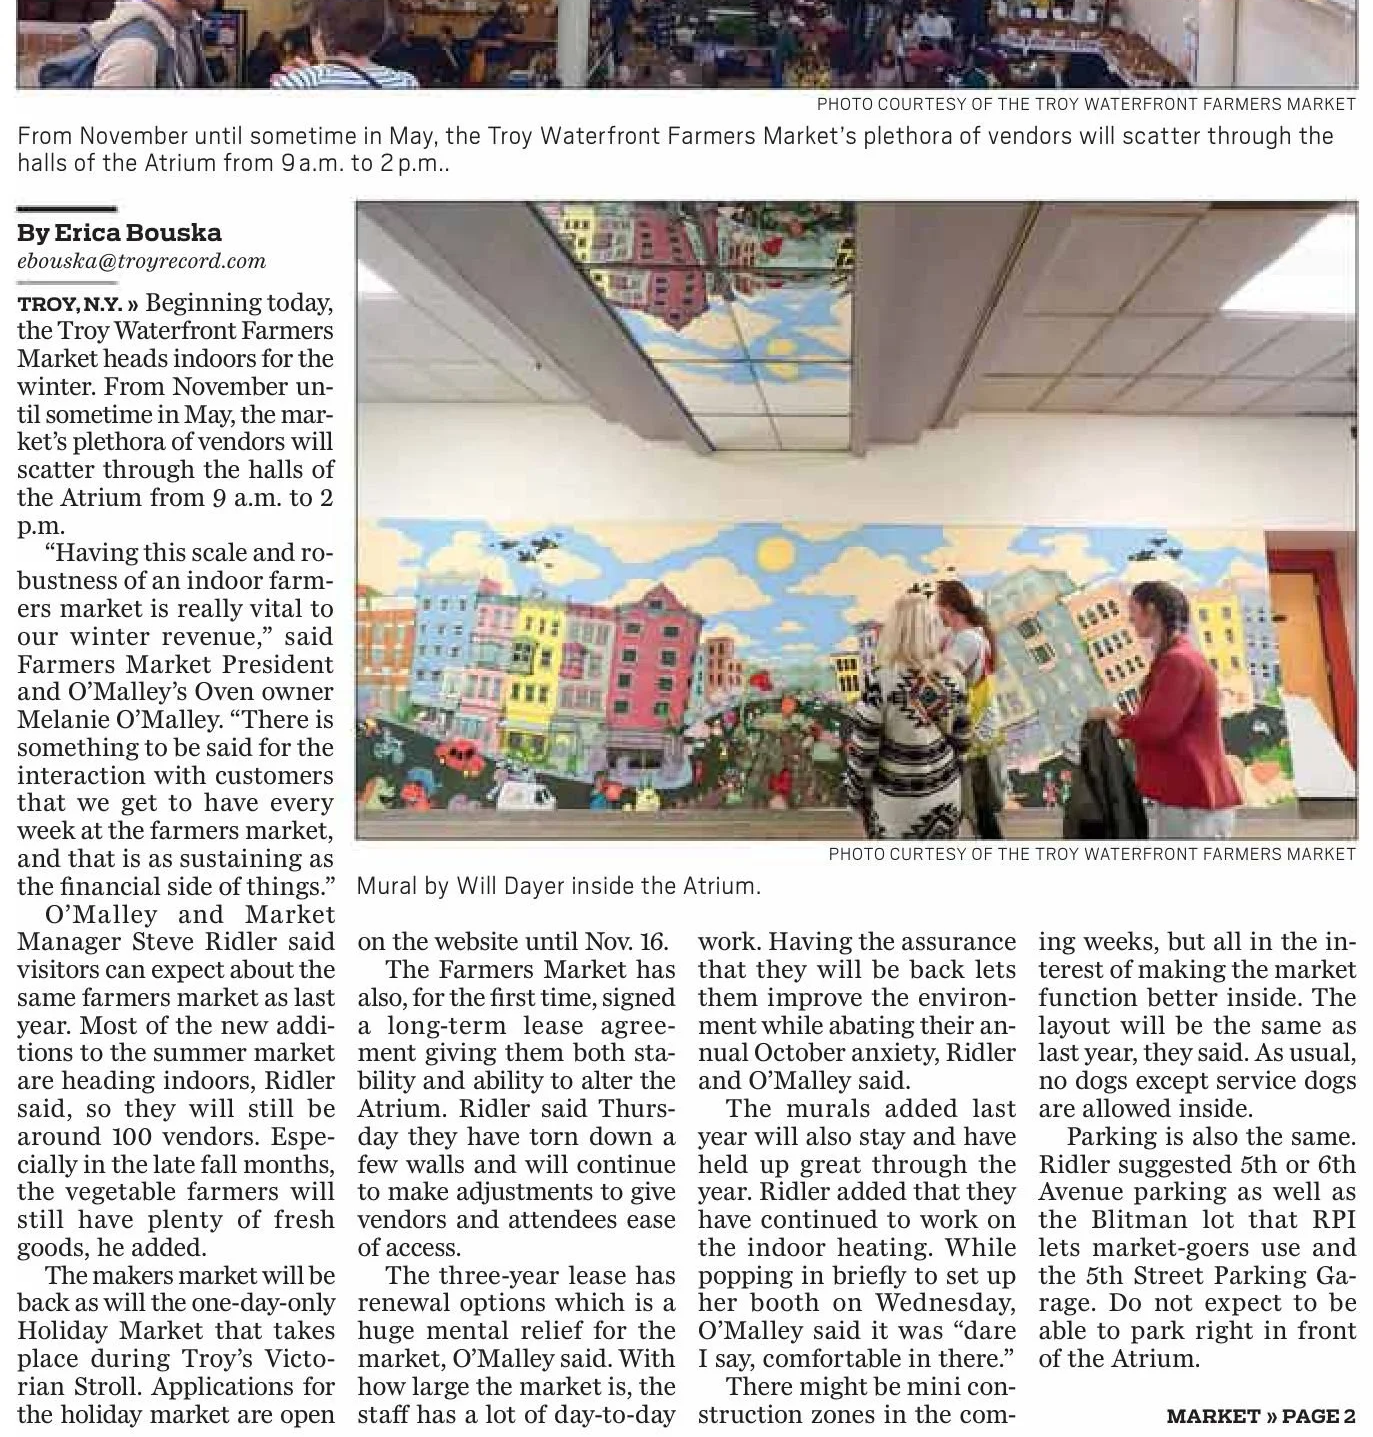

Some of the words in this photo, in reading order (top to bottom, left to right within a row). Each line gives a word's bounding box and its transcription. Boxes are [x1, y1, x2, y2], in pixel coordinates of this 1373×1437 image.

[818, 98, 872, 110] PHOTO
[879, 98, 966, 110] COURTESY
[972, 98, 992, 110] OF
[998, 98, 1029, 110] THE
[1036, 98, 1078, 110] TROY
[1085, 98, 1197, 110] WATERFRONT
[1204, 98, 1281, 110] FARMERS
[1288, 98, 1356, 110] MARKET
[19, 127, 71, 144] From
[81, 126, 187, 144] November
[196, 126, 241, 144] until
[251, 127, 356, 144] sometime
[365, 127, 381, 144] in
[391, 127, 437, 149] May,
[446, 126, 480, 144] the
[488, 127, 532, 149] Troy
[541, 126, 659, 144] Waterfront
[669, 127, 755, 144] Farmers
[765, 126, 856, 144] Market’s
[865, 126, 951, 149] plethora
[960, 126, 980, 144] of
[989, 126, 1071, 144] vendors
[1080, 126, 1113, 144] will
[1123, 128, 1200, 144] scatter
[1208, 126, 1290, 149] through
[1299, 126, 1333, 144] the
[19, 153, 66, 171] halls
[75, 153, 95, 171] of
[103, 153, 136, 171] the
[145, 154, 215, 171] Atrium
[224, 153, 272, 171] from
[351, 154, 372, 171] to
[18, 224, 50, 245] By
[55, 223, 121, 241] Erica
[127, 223, 222, 241] Bouska
[18, 253, 266, 272] ebouska@troyrecord.com
[18, 521, 64, 539] p.m.
[46, 543, 138, 565] “Having
[144, 543, 185, 561] this
[192, 542, 247, 561] scale
[254, 543, 295, 561] and
[301, 548, 333, 561] ro-
[18, 682, 60, 700] and
[69, 682, 186, 705] O’Malley’s
[195, 682, 254, 700] Oven
[262, 687, 334, 700] owner
[17, 793, 65, 811] that
[77, 798, 109, 811] we
[122, 795, 157, 815] get
[169, 795, 191, 811] to
[204, 793, 258, 811] have
[271, 798, 334, 816] every
[830, 848, 884, 860] PHOTO
[891, 848, 966, 860] CURTESY
[972, 848, 992, 860] OF
[998, 848, 1029, 860] THE
[1036, 848, 1078, 860] TROY
[1085, 848, 1197, 860] WATERFRONT
[1204, 848, 1281, 860] FARMERS
[1288, 848, 1356, 860] MARKET
[358, 876, 415, 894] Mural
[426, 876, 448, 899] by
[457, 876, 495, 894] Will
[506, 877, 564, 899] Dayer
[573, 876, 633, 894] inside
[641, 876, 675, 894] the
[684, 876, 760, 894] Atrium.
[46, 905, 157, 927] O’Malley
[179, 905, 223, 923] and
[245, 904, 335, 923] Market
[358, 937, 385, 950] on
[393, 932, 428, 950] the
[435, 931, 518, 950] website
[526, 932, 578, 950] until
[585, 932, 632, 950] Nov.
[641, 932, 668, 950] 16.
[698, 932, 761, 950] work.
[769, 932, 852, 954] Having
[859, 932, 894, 950] the
[902, 937, 1016, 950] assurance
[1039, 987, 1137, 1006] function
[1147, 988, 1217, 1007] better
[1227, 987, 1302, 1006] inside.
[1312, 988, 1356, 1006] The
[359, 1021, 371, 1034] a
[388, 1015, 506, 1039] long-term
[524, 1015, 583, 1034] lease
[602, 1021, 675, 1038] agree-
[726, 1099, 771, 1117] The
[787, 1099, 869, 1117] murals
[886, 1098, 957, 1117] added
[973, 1099, 1016, 1117] last
[1068, 1127, 1157, 1149] Parking
[1166, 1127, 1183, 1145] is
[1193, 1127, 1237, 1145] also
[1246, 1126, 1282, 1145] the
[1292, 1132, 1355, 1145] same.
[358, 1237, 381, 1256] of
[387, 1243, 460, 1256] access.
[698, 1238, 735, 1256] the
[748, 1238, 825, 1256] indoor
[837, 1237, 932, 1261] heating.
[945, 1238, 1016, 1256] While
[358, 1293, 450, 1311] renewal
[460, 1293, 545, 1316] options
[555, 1292, 624, 1311] which
[635, 1293, 652, 1311] is
[664, 1298, 676, 1311] a
[1039, 1348, 1062, 1367] of
[1068, 1349, 1104, 1367] the
[1111, 1349, 1199, 1367] Atrium.
[17, 1405, 52, 1423] the
[61, 1404, 142, 1427] holiday
[150, 1404, 229, 1423] market
[238, 1410, 272, 1423] are
[281, 1410, 335, 1428] open
[699, 1405, 802, 1423] struction
[812, 1410, 874, 1423] zones
[884, 1405, 906, 1423] in
[915, 1405, 951, 1423] the
[960, 1410, 1015, 1423] com-
[1167, 1409, 1261, 1423] MARKET
[1283, 1409, 1339, 1423] PAGE
[1344, 1409, 1355, 1423] 2
